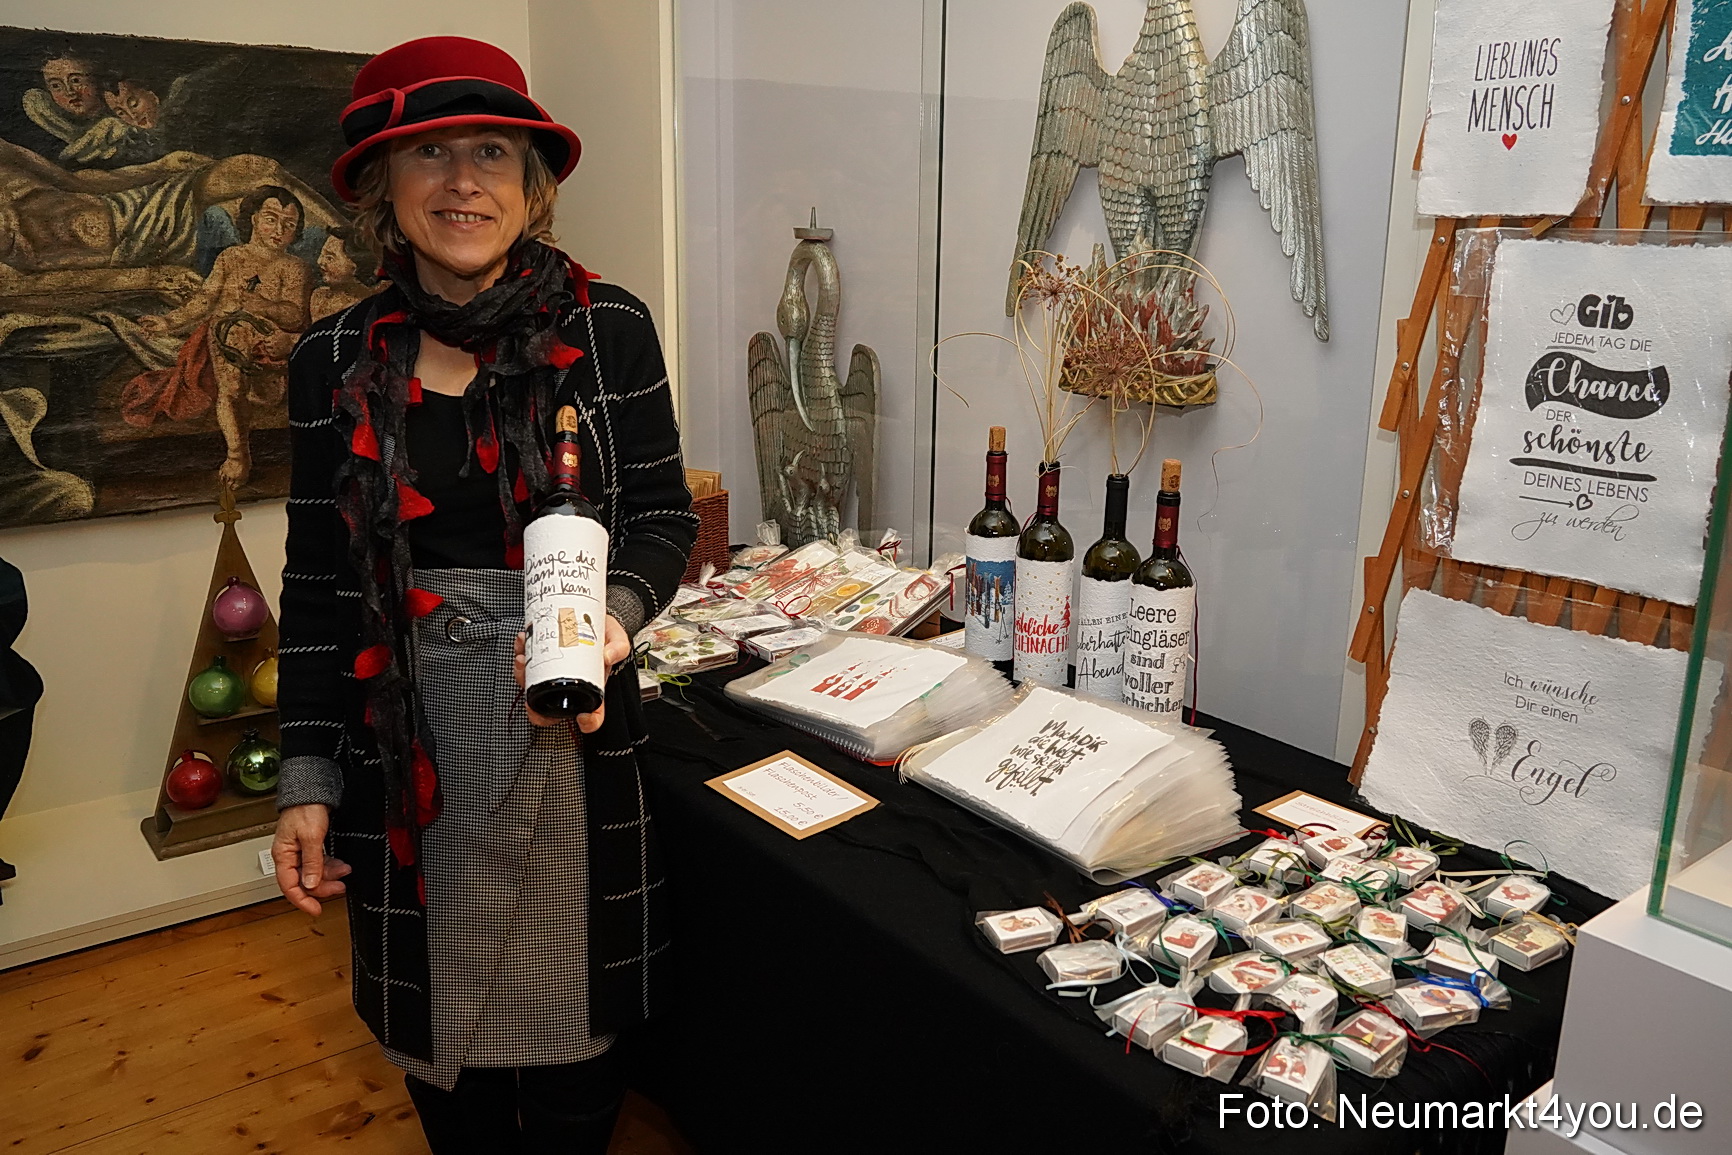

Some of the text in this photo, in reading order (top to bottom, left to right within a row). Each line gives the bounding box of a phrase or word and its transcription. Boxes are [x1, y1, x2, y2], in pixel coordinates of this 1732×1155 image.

[1474, 38, 1561, 81] LIEBLINGS
[1468, 83, 1555, 132] MENSCH
[1551, 332, 1652, 352] JEDEM TAG DIE
[1534, 357, 1661, 402] Chance
[1546, 409, 1572, 423] DER
[1523, 424, 1652, 465] schönste
[1524, 471, 1649, 502] DEINES LEBENS
[1511, 504, 1640, 541] zu werden
[558, 565, 593, 580] nicht
[575, 550, 599, 572] die
[561, 578, 591, 595] kann
[1105, 612, 1128, 624] EINE
[1129, 598, 1177, 624] Leere
[1078, 651, 1126, 690] Abend
[1131, 651, 1166, 669] sind
[1123, 672, 1174, 695] voller
[1503, 672, 1600, 706] Ich wünsche
[1515, 695, 1578, 724] Dir einen
[763, 768, 817, 801] Flaschenpost
[1511, 740, 1617, 805] Engel
